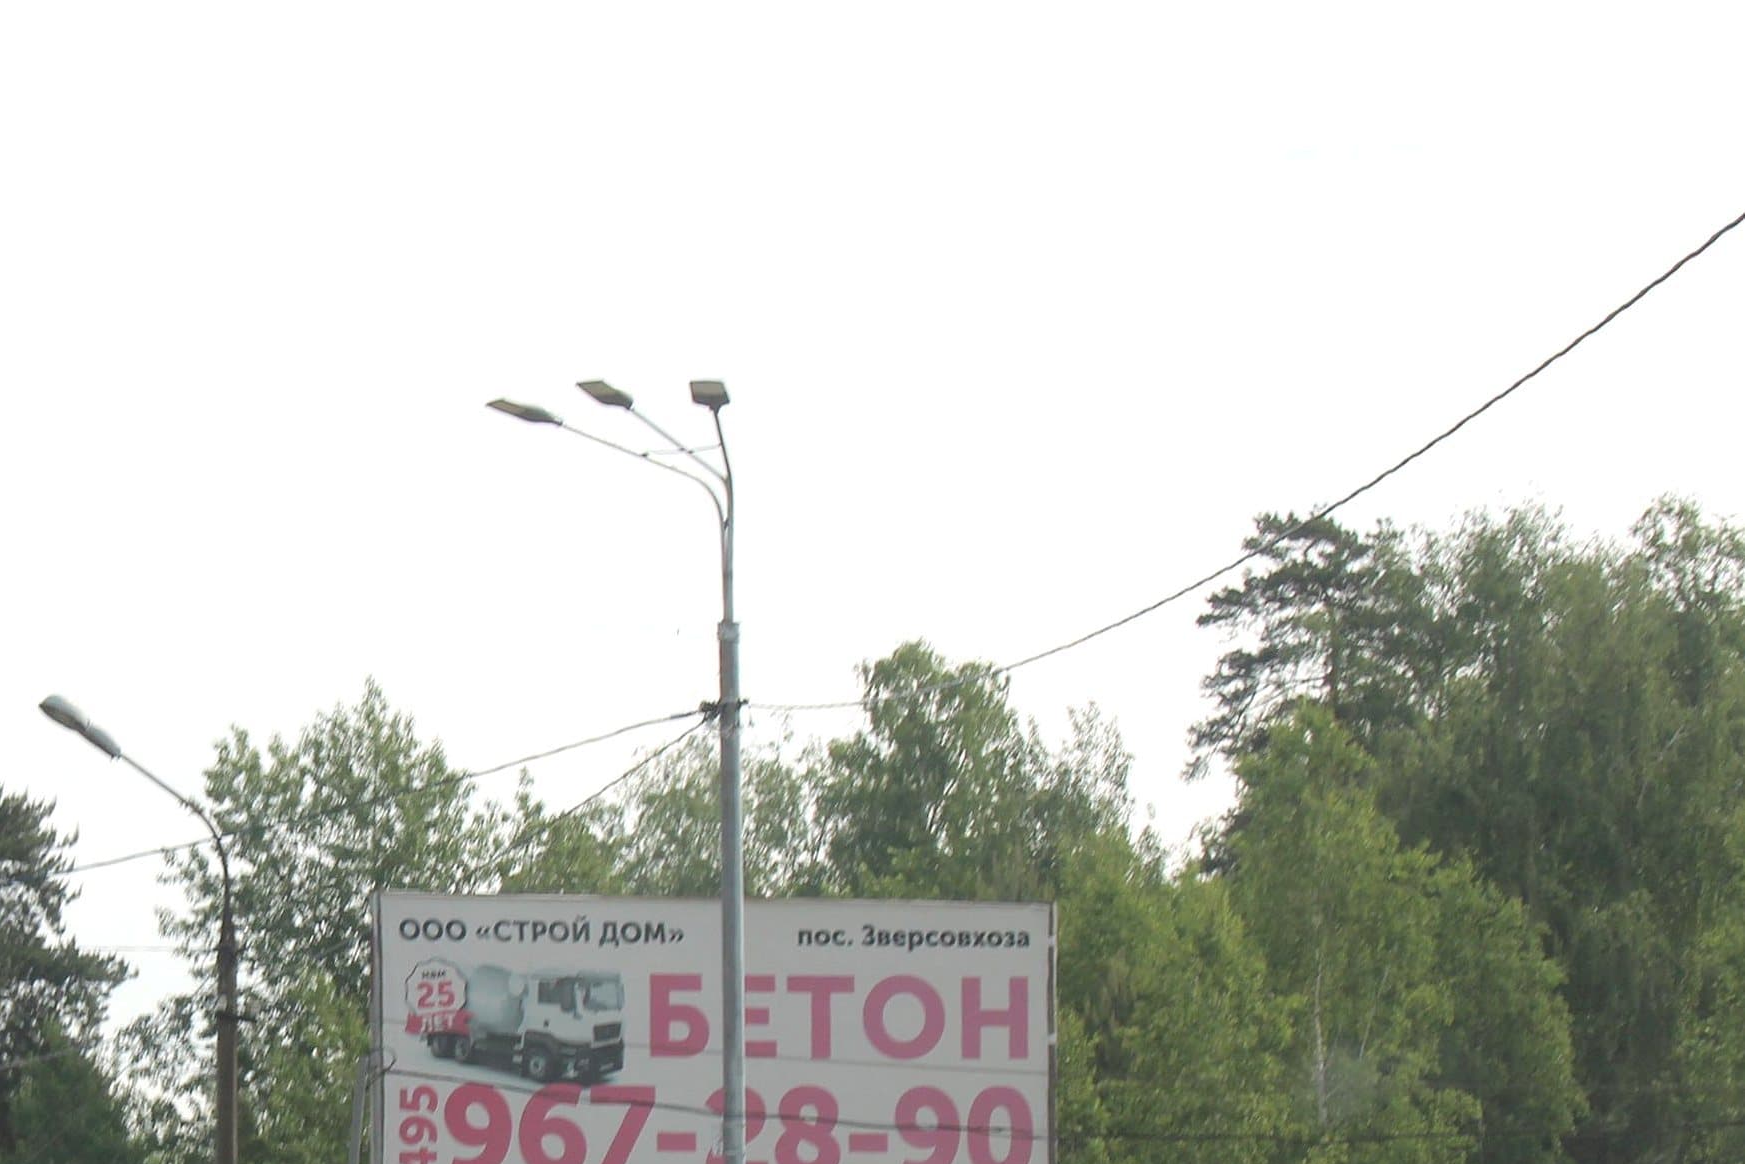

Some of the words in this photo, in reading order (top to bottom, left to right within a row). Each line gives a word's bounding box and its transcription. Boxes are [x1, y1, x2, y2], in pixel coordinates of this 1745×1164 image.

[399, 918, 466, 942] ООО
[475, 915, 591, 943] «СТРОЙ
[598, 921, 685, 948] ДОМ»
[797, 927, 853, 947] пос.
[861, 924, 1030, 951] Зверсовхоза
[416, 980, 456, 1010] 25
[419, 1012, 455, 1034] ЛЕТ
[649, 972, 1030, 1061] БЕТОН
